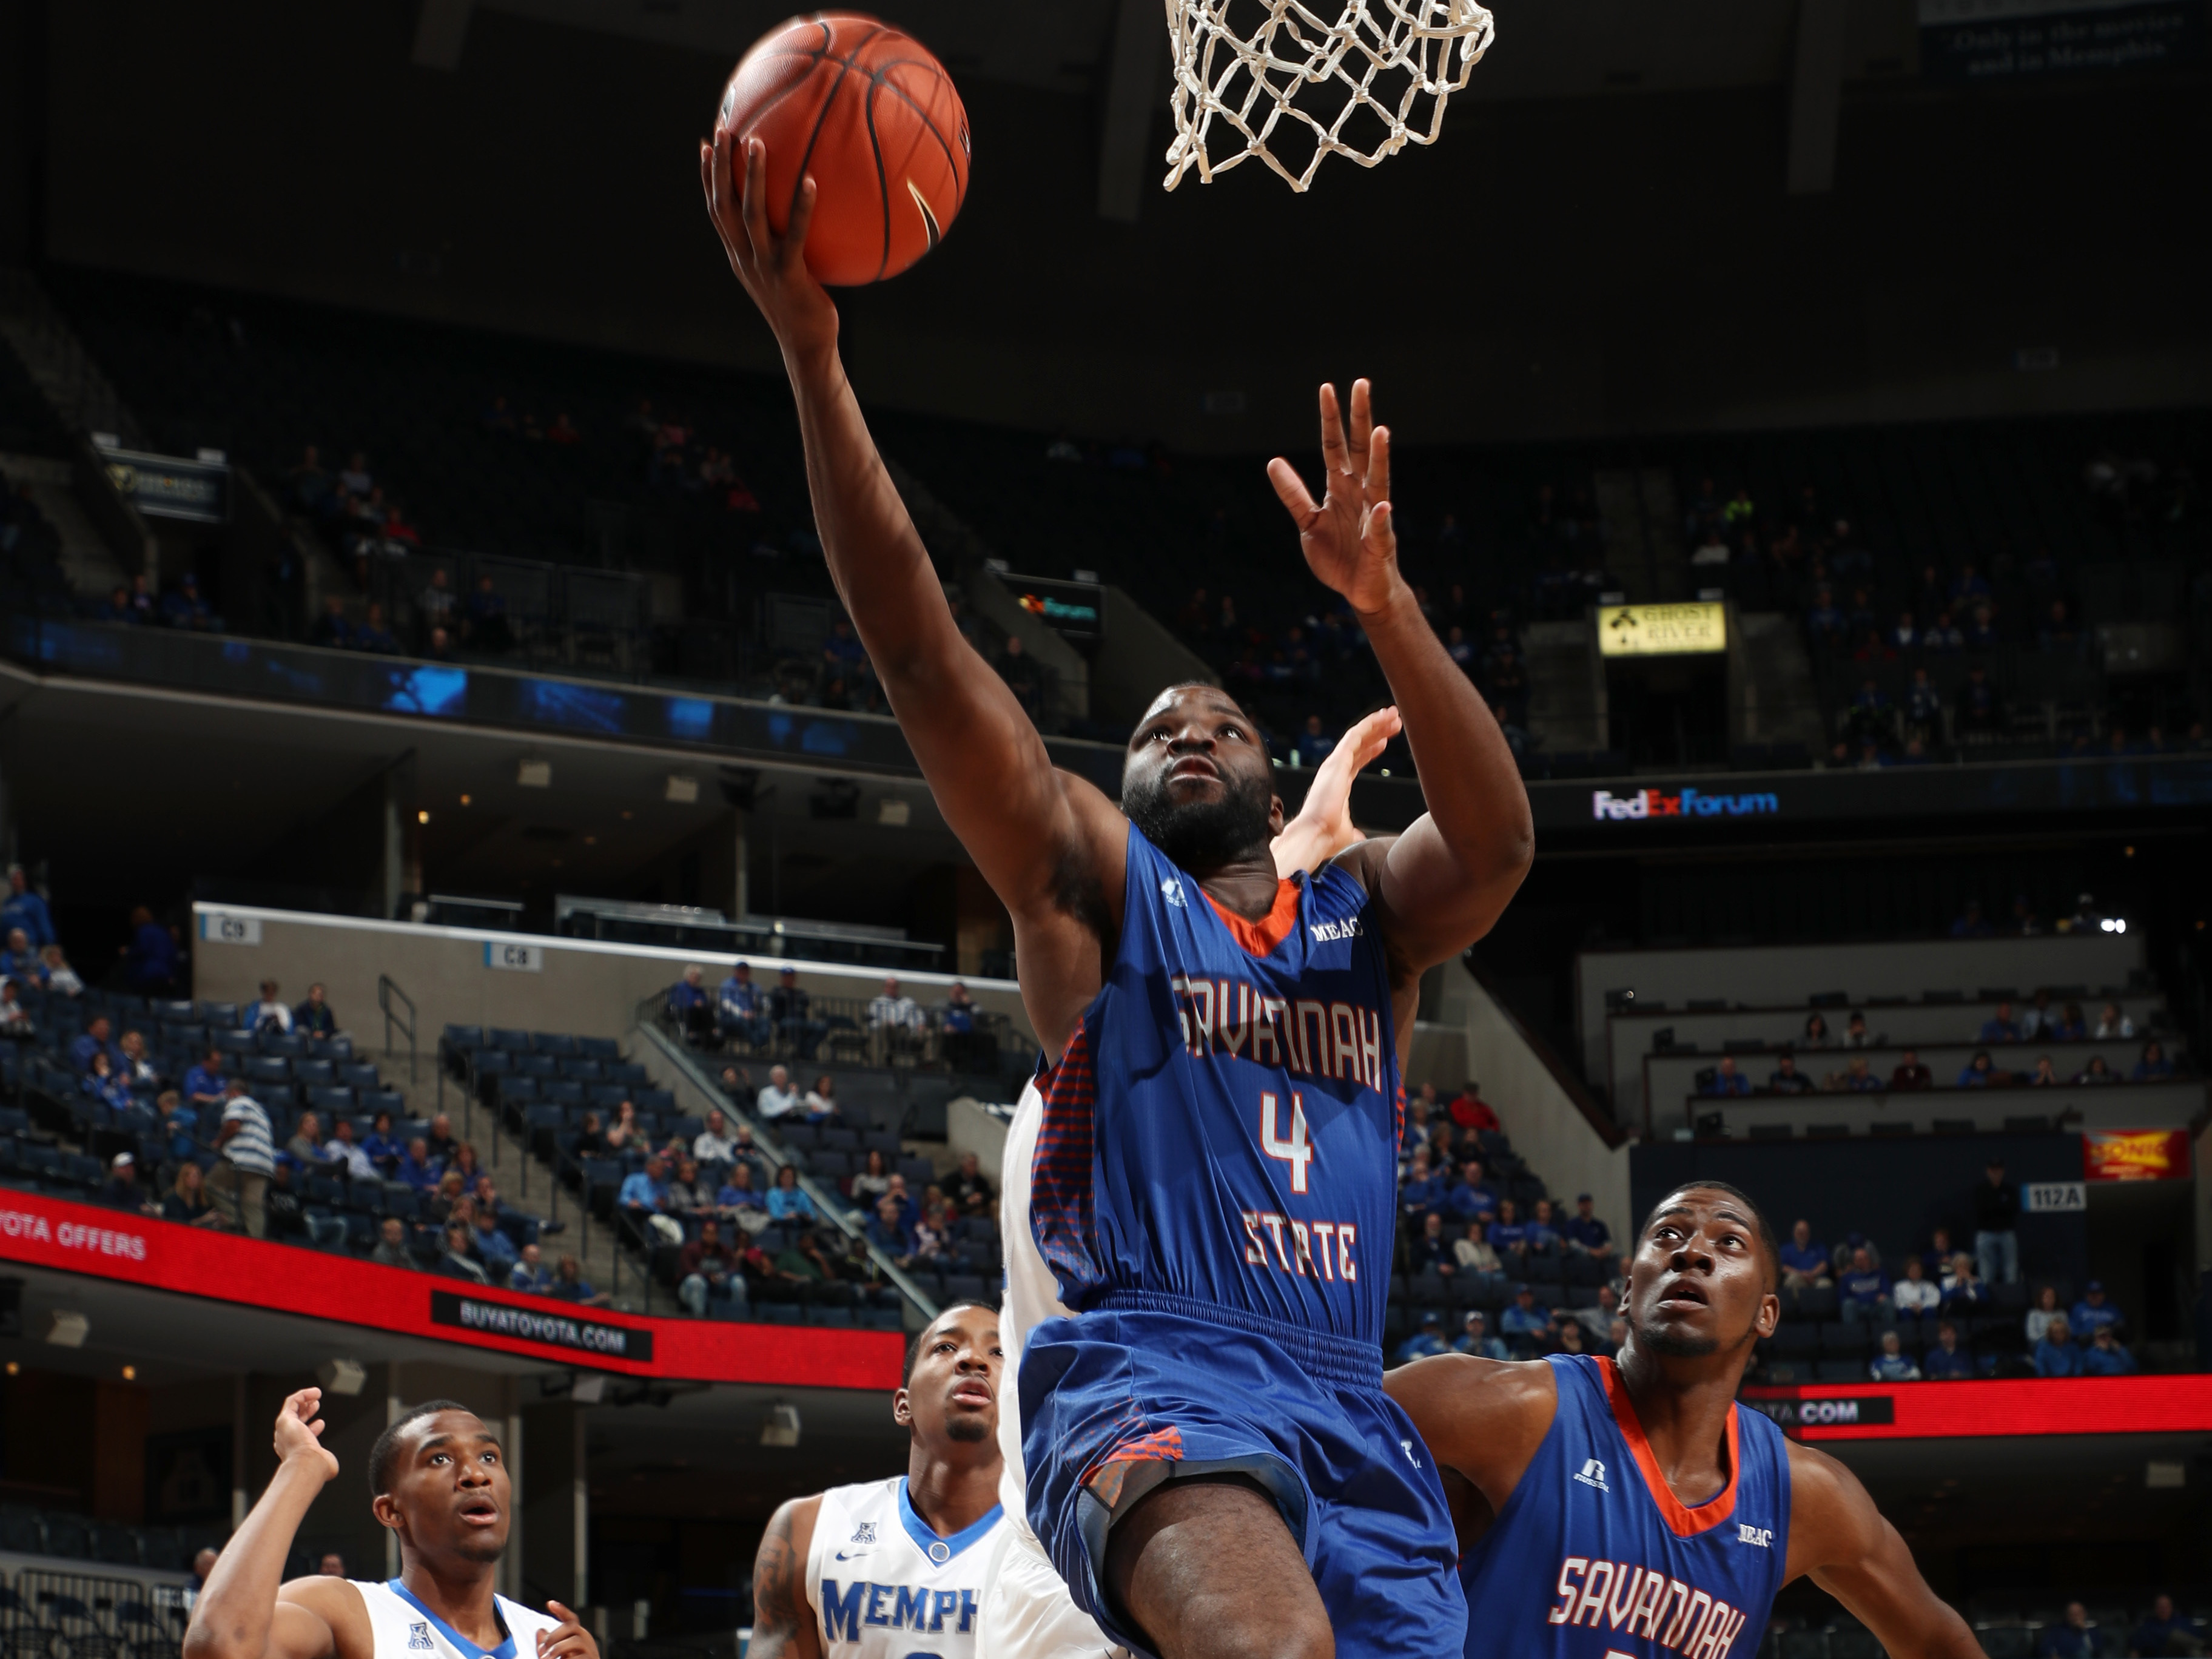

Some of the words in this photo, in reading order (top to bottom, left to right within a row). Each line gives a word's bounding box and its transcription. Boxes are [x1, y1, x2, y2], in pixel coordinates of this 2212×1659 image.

[1644, 606, 1711, 621] GHOST
[1649, 624, 1710, 638] RIVER
[1593, 787, 1779, 820] FedExForum
[221, 918, 245, 937] C9
[1309, 915, 1363, 942] MEAC
[504, 945, 527, 966] C8
[1171, 975, 1382, 1094] SAVANNAH
[1259, 1090, 1314, 1194] 4
[2034, 1186, 2080, 1206] 112A
[0, 1209, 52, 1243] OTA
[56, 1221, 147, 1262] OFFERS
[1242, 1210, 1358, 1283] STATE
[460, 1299, 627, 1355] BUYATOYOTA.COM
[1547, 1555, 1747, 1659] SAVANNAH
